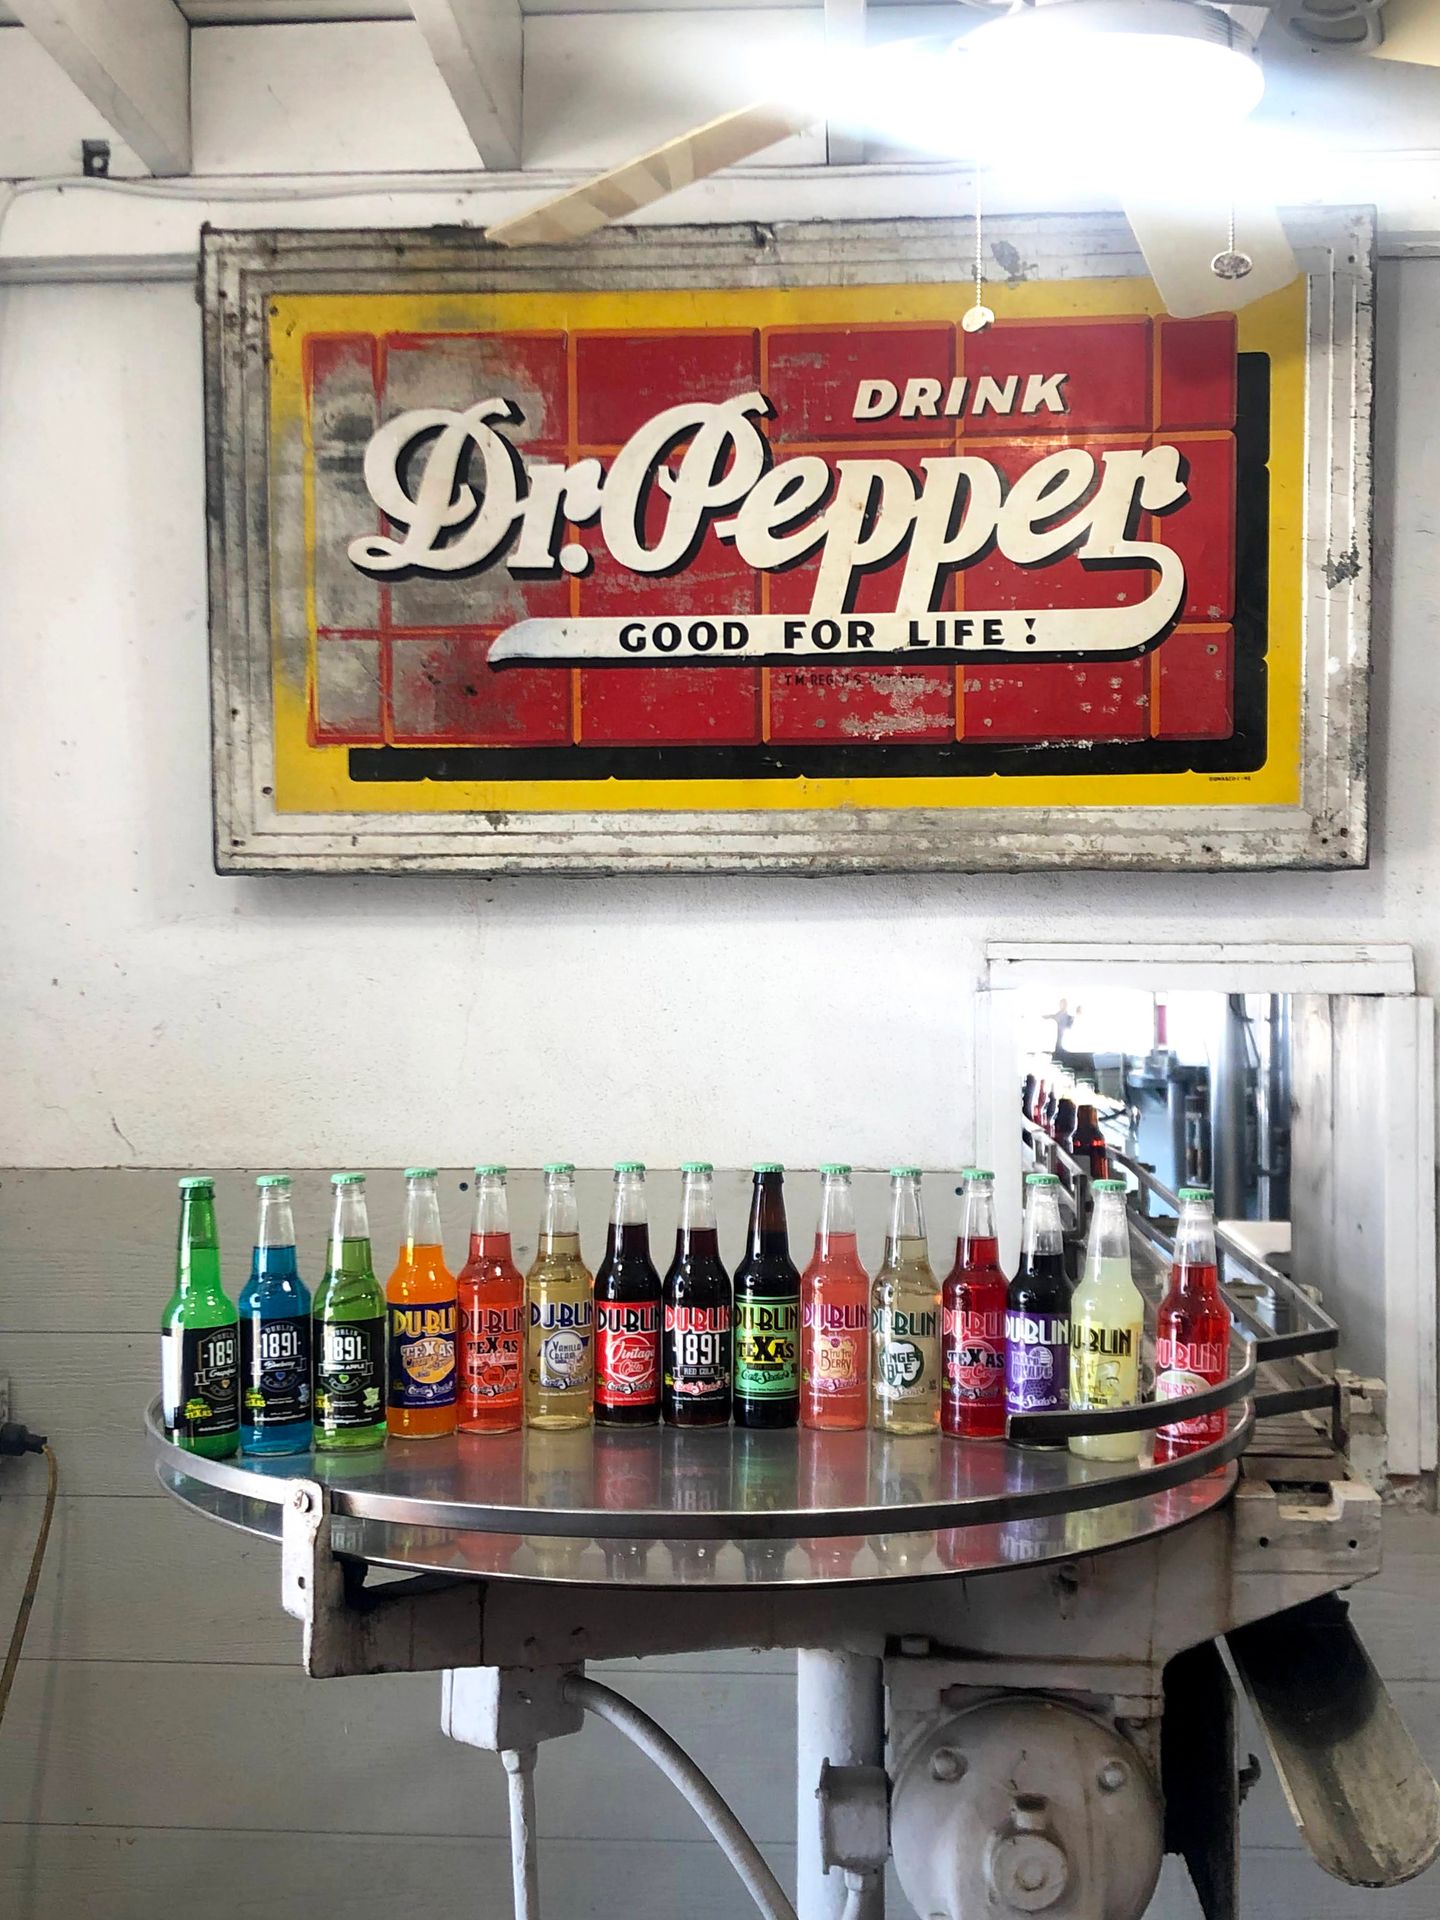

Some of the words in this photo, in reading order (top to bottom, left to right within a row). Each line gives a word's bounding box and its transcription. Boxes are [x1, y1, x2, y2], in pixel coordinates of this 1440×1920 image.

[853, 374, 1068, 419] DRINK
[347, 397, 602, 575] Dr.
[600, 391, 1187, 614] Pepper
[619, 621, 750, 653] GOOD
[783, 619, 876, 650] FOR
[393, 1306, 457, 1338] DUBLI
[1005, 1313, 1069, 1345] DUBLIN
[262, 1331, 298, 1358] 1891
[403, 1341, 455, 1359] TEXAS
[467, 1337, 518, 1354] TEXAS
[676, 1334, 720, 1365] 1891
[1070, 1322, 1132, 1357] UBLIN
[684, 1367, 697, 1376] RED
[699, 1367, 715, 1375] COLA
[887, 1362, 913, 1378] ALE
[947, 1348, 1004, 1369] TEXAS
